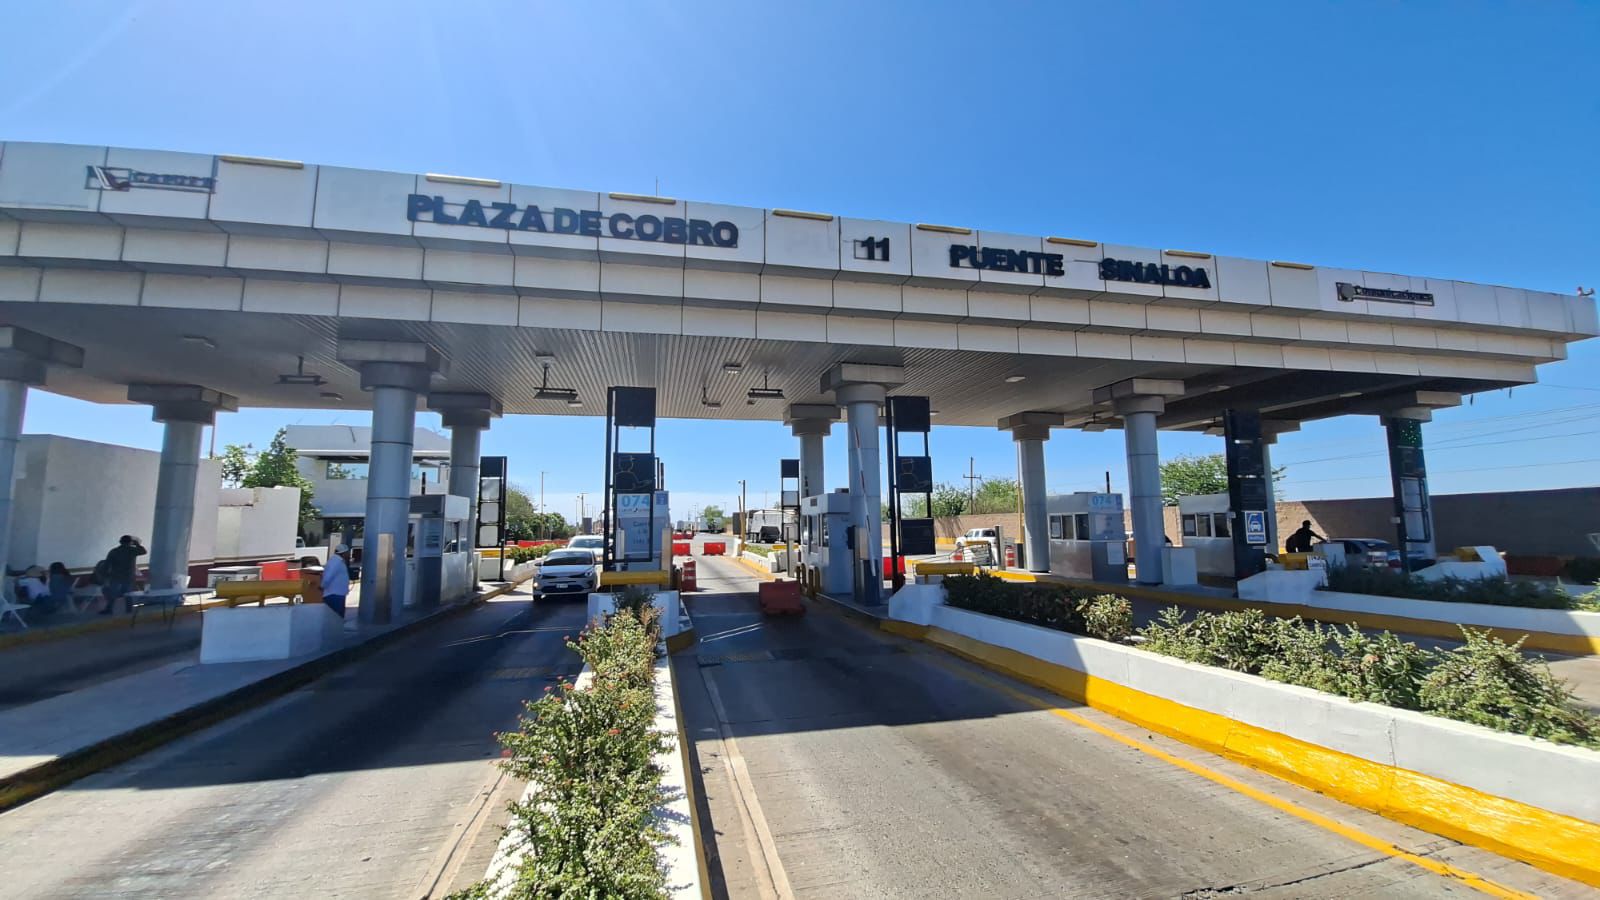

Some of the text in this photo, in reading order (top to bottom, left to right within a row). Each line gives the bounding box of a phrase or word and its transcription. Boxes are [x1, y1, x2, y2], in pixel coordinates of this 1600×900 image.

[407, 193, 739, 249] PLAZA DE COBRO
[860, 236, 890, 262] 11
[949, 243, 1212, 289] PUENTE SINALOA
[621, 495, 650, 507] 074
